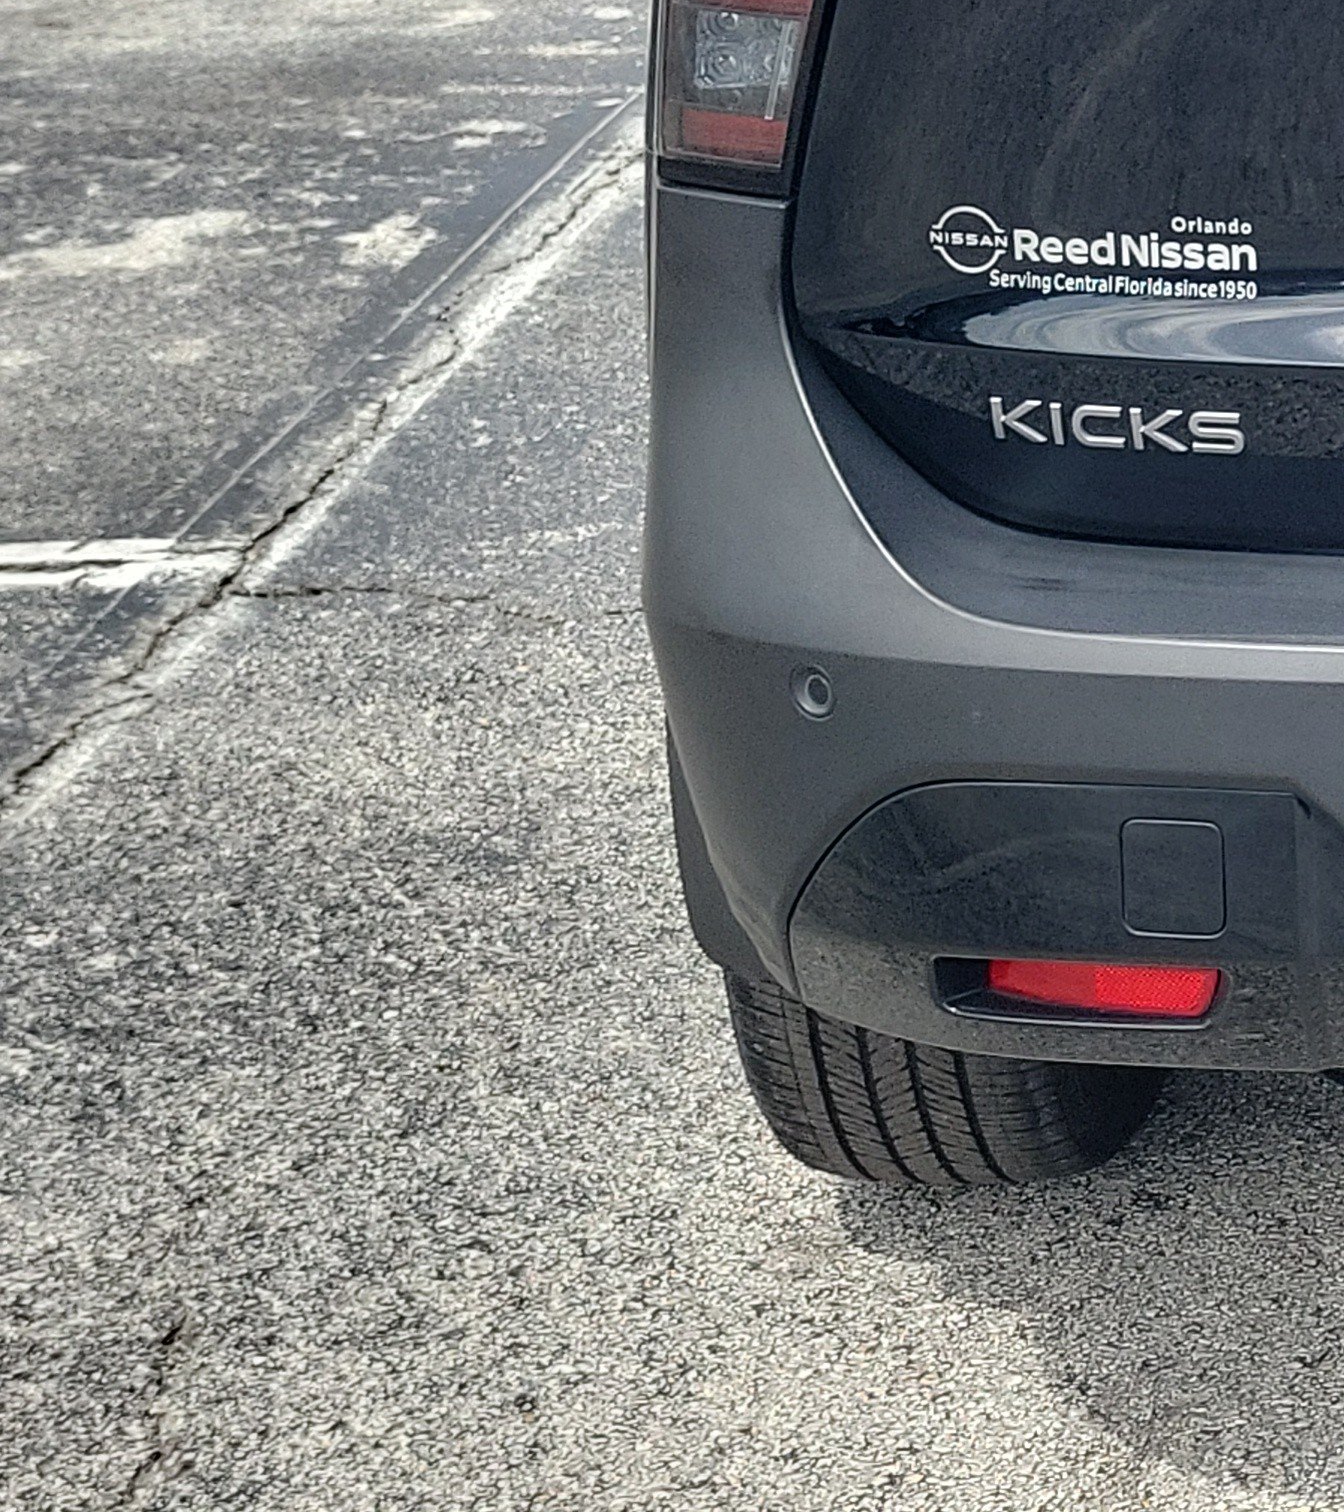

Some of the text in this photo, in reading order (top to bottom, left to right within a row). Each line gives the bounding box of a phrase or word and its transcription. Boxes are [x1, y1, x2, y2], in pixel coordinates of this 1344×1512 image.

[929, 230, 1008, 248] NISSAN
[1171, 216, 1252, 235] Orlando
[1013, 228, 1257, 271] Reed Nissan
[989, 269, 1257, 300] Serving Central Florida since 1950
[989, 396, 1245, 455] KICKS
